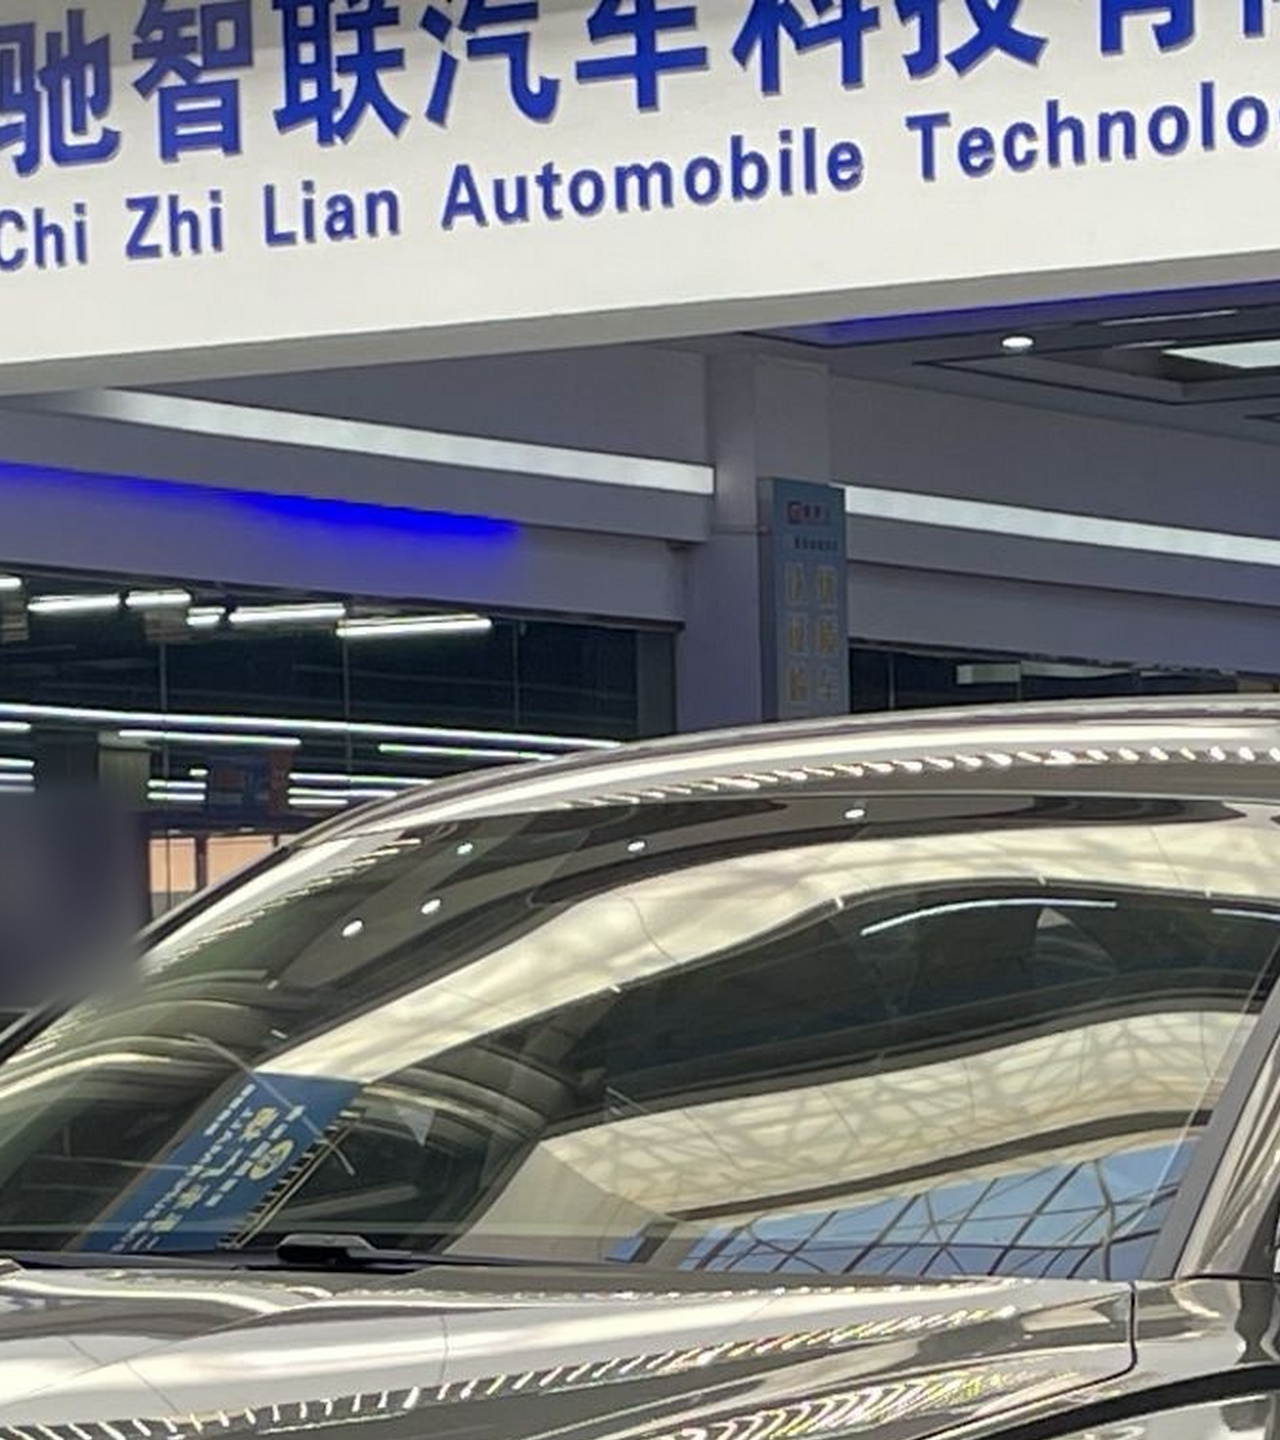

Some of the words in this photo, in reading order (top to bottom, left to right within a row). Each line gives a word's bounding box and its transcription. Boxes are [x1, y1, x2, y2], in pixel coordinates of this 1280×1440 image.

[125, 190, 224, 260] Zhi
[263, 180, 401, 248] Lian
[439, 127, 864, 231] Automobile
